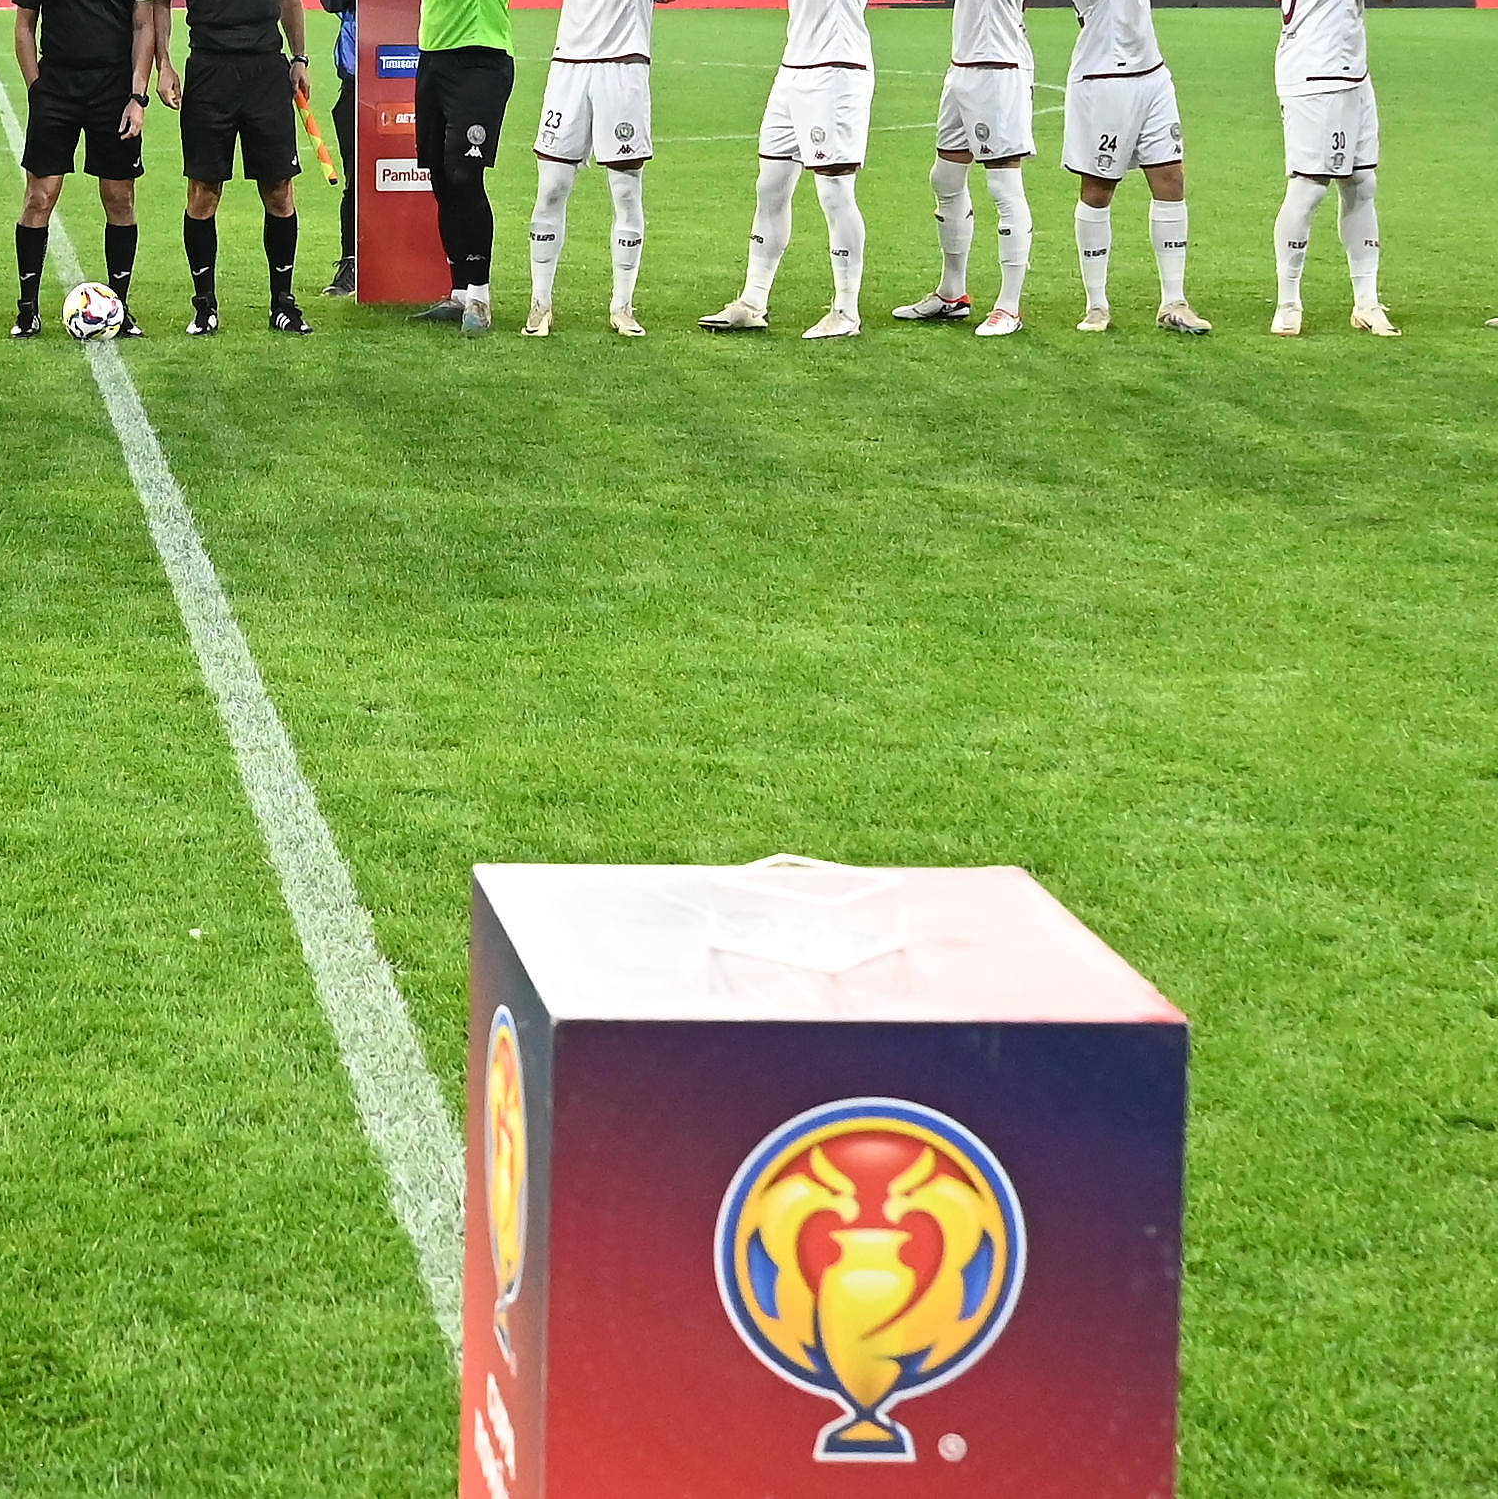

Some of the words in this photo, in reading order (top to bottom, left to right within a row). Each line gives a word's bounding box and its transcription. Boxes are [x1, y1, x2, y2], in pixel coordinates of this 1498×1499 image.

[545, 110, 563, 128] 23
[1099, 135, 1116, 153] 24
[1331, 132, 1346, 151] 30
